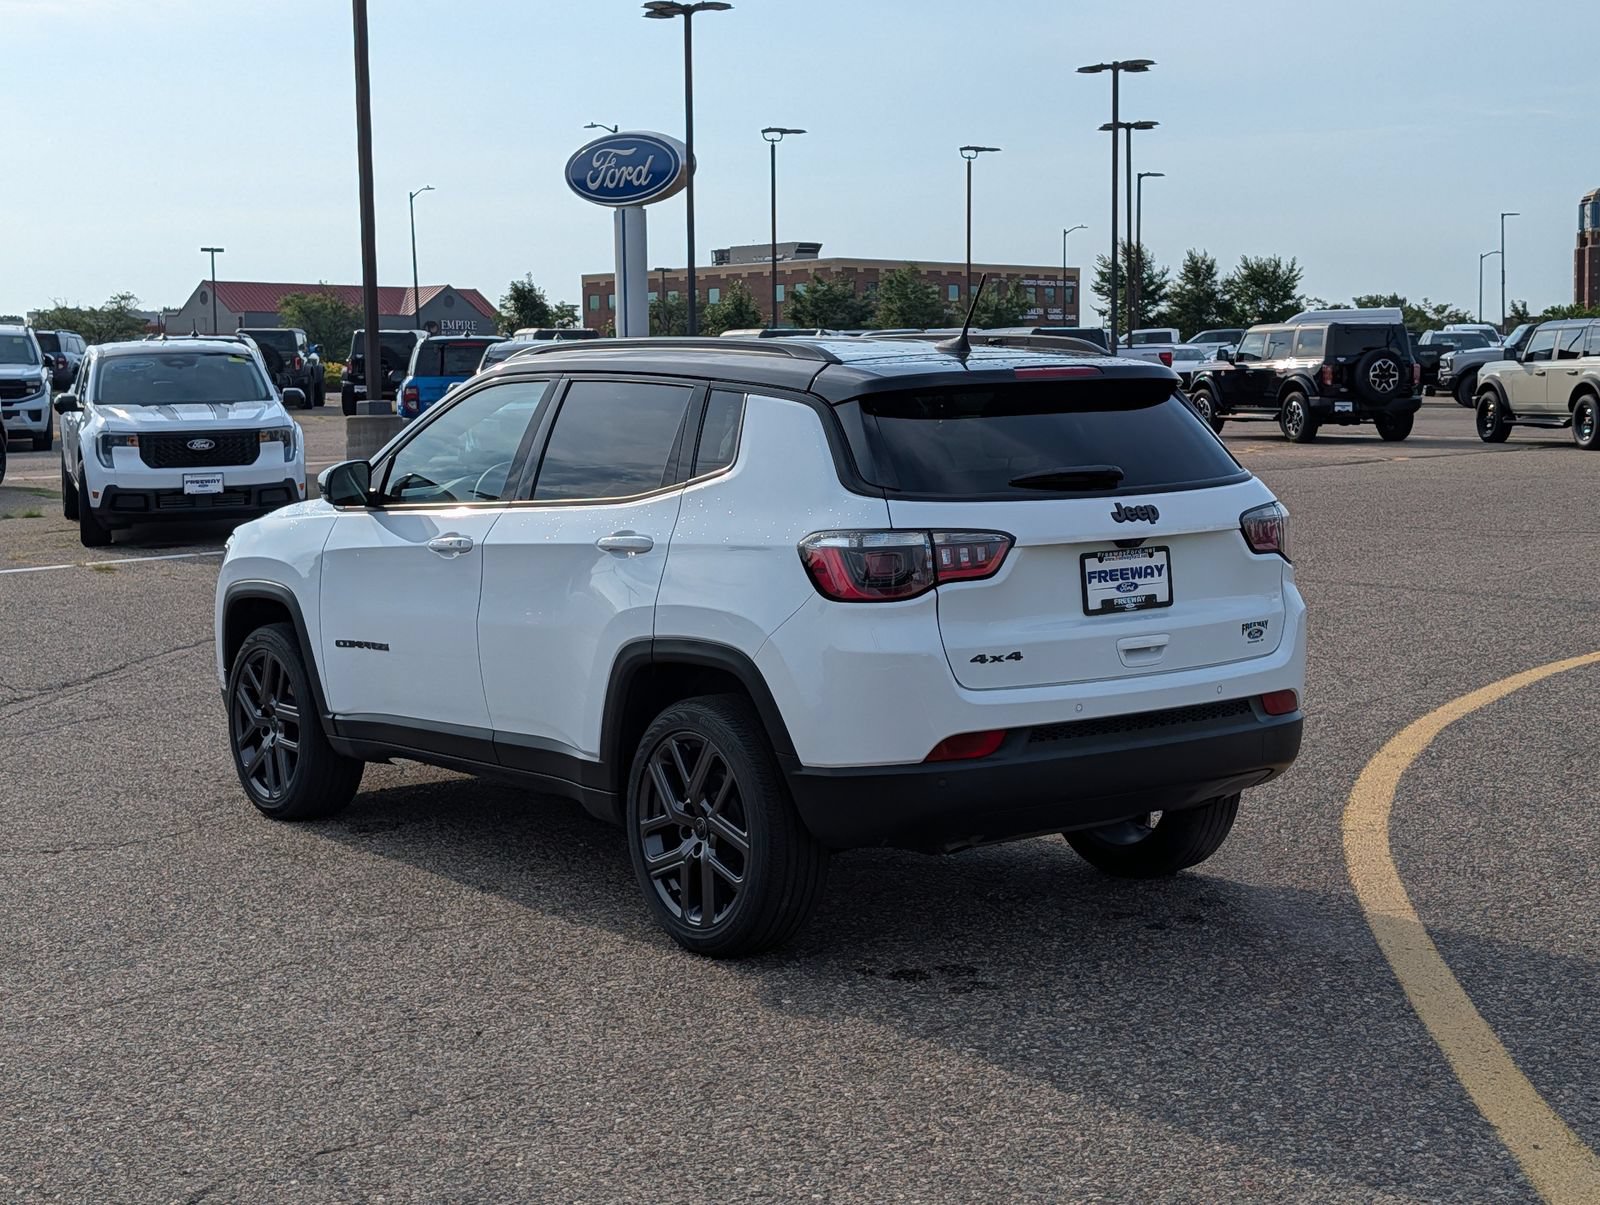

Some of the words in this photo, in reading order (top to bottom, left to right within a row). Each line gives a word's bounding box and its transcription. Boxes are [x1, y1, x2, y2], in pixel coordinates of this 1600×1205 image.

[587, 147, 655, 190] Ford
[441, 319, 478, 330] EMPIRE
[1111, 502, 1160, 524] Jeep
[1087, 563, 1165, 585] FREEWAY
[1118, 582, 1137, 592] Ford
[1113, 595, 1146, 606] FREEWAY
[1241, 619, 1269, 636] FREEWAY
[970, 650, 1024, 665] 4x4
